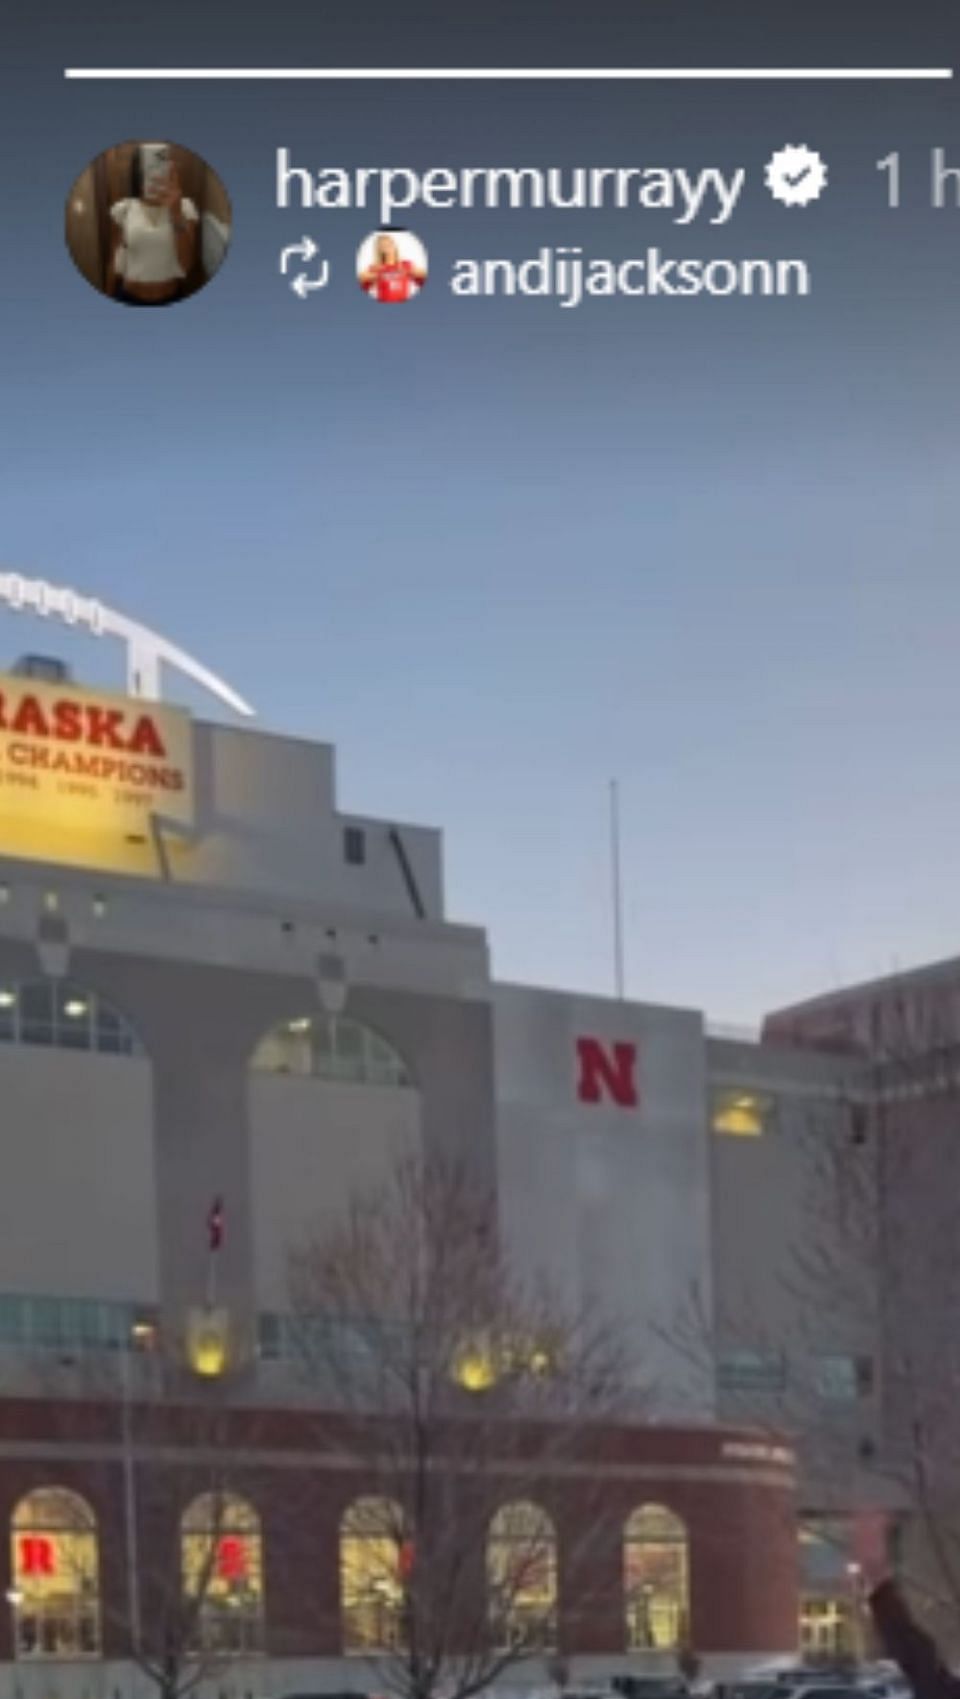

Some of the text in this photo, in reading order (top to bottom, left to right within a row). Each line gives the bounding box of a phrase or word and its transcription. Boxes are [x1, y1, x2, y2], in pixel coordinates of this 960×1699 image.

[0, 688, 167, 757] ASKA
[7, 741, 185, 791] CHAMPIONS
[576, 1036, 638, 1107] N
